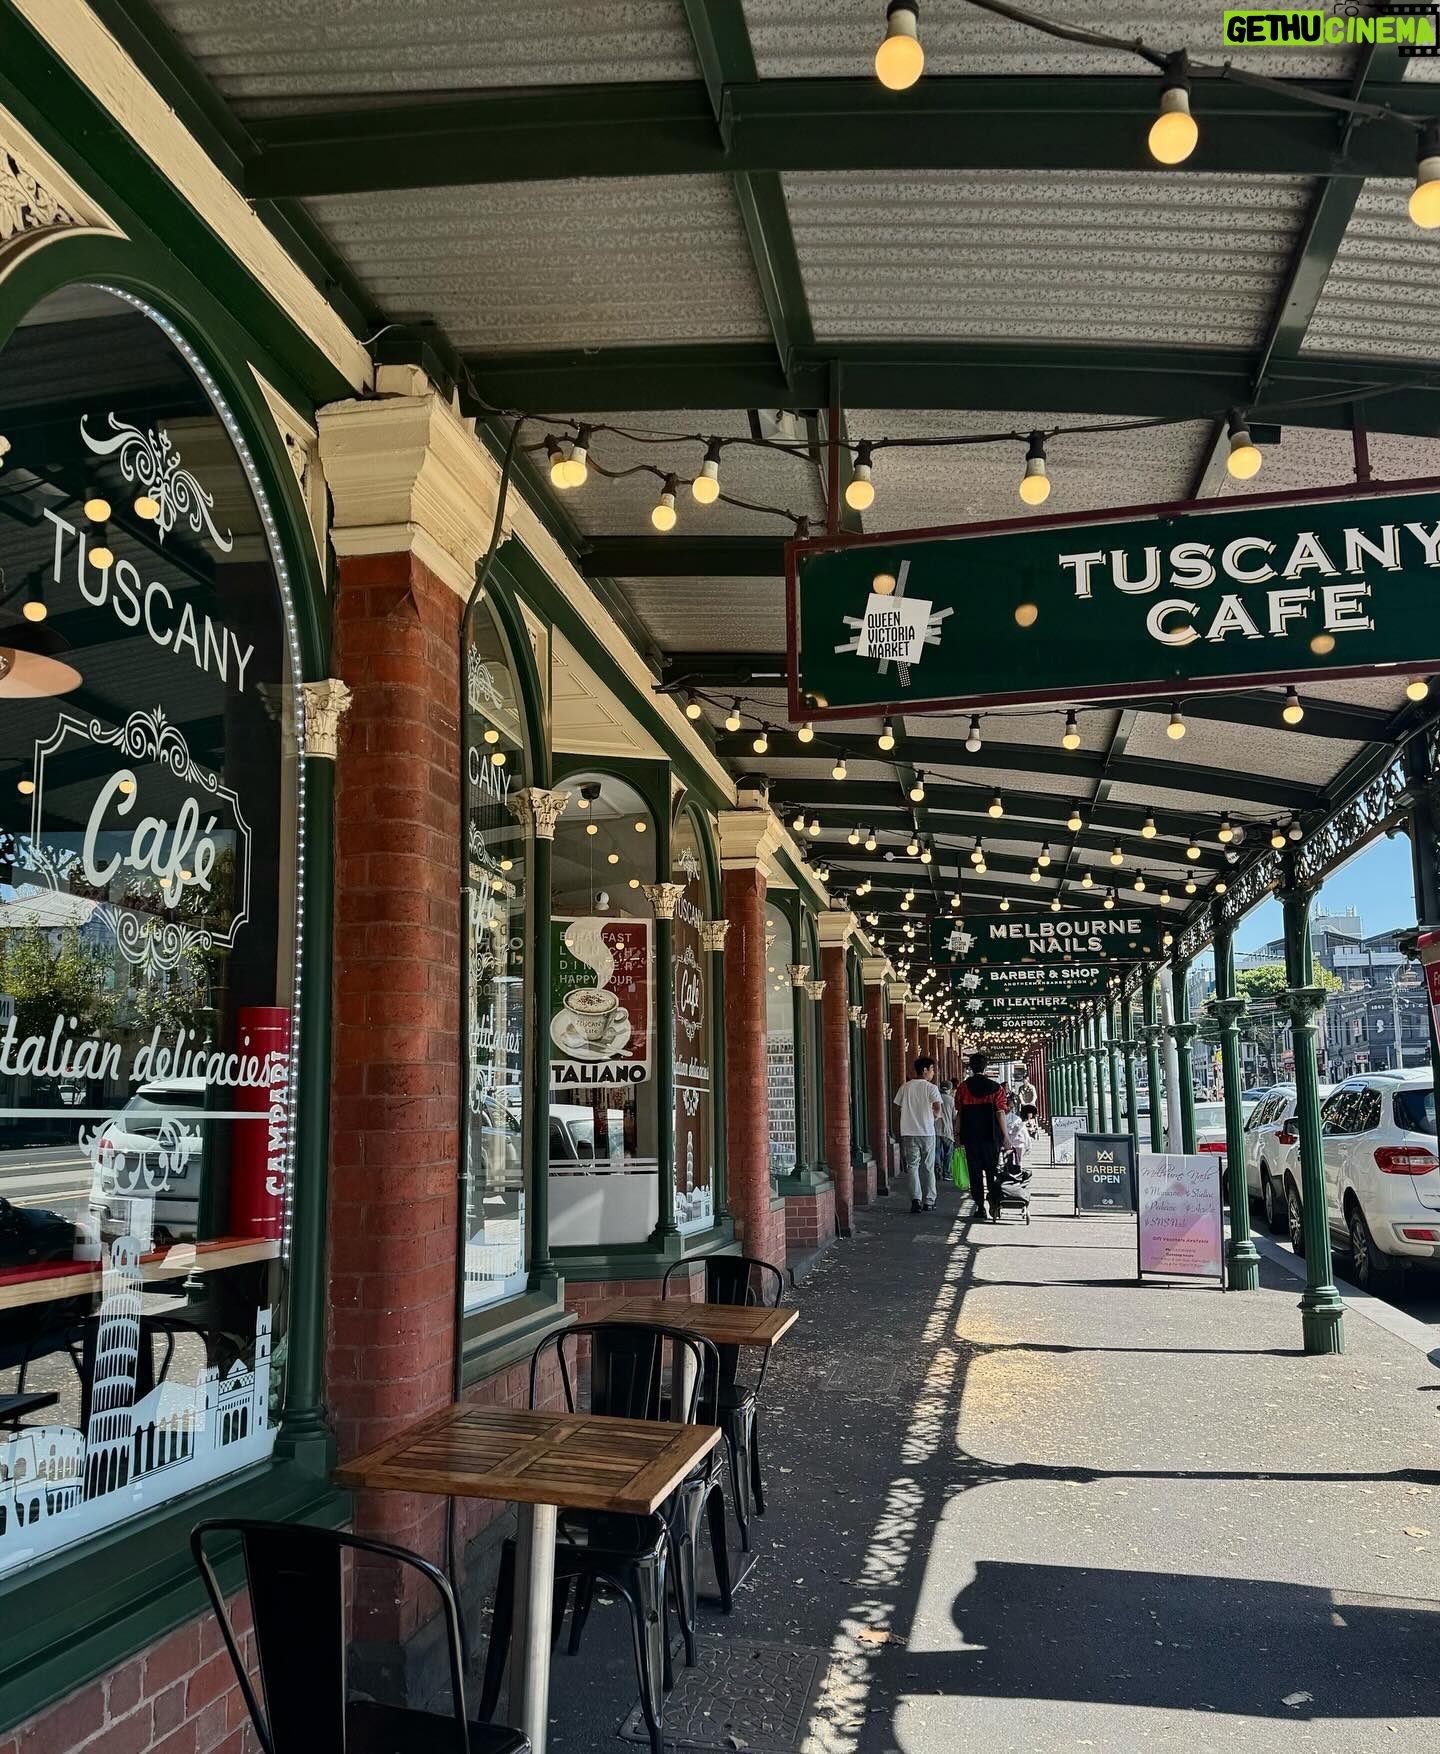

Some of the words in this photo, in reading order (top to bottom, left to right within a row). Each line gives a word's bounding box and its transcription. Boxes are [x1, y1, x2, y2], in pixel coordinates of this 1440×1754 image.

[1058, 520, 1440, 599] TUSCANY
[44, 507, 254, 692] TUSCANY
[867, 611, 901, 628] QUEEN
[1146, 581, 1374, 647] CAFE
[867, 625, 916, 644] VICTORIA
[868, 641, 910, 659] MARKET
[83, 769, 217, 909] Café
[989, 919, 1142, 939] MELBOURNE
[1029, 937, 1103, 954] NAILS
[560, 974, 598, 984] HAPPY
[990, 970, 1046, 980] BARBER
[1048, 969, 1059, 979] &
[1061, 968, 1100, 978] SHOP
[992, 998, 1005, 1007] IN
[1008, 997, 1068, 1007] LEATHERZ
[129, 1025, 275, 1088] delicacies
[552, 1064, 647, 1083] TALIANO
[265, 1051, 290, 1196] CAMPARI
[1086, 1165, 1127, 1175] BARBER
[1093, 1174, 1121, 1183] OPEN
